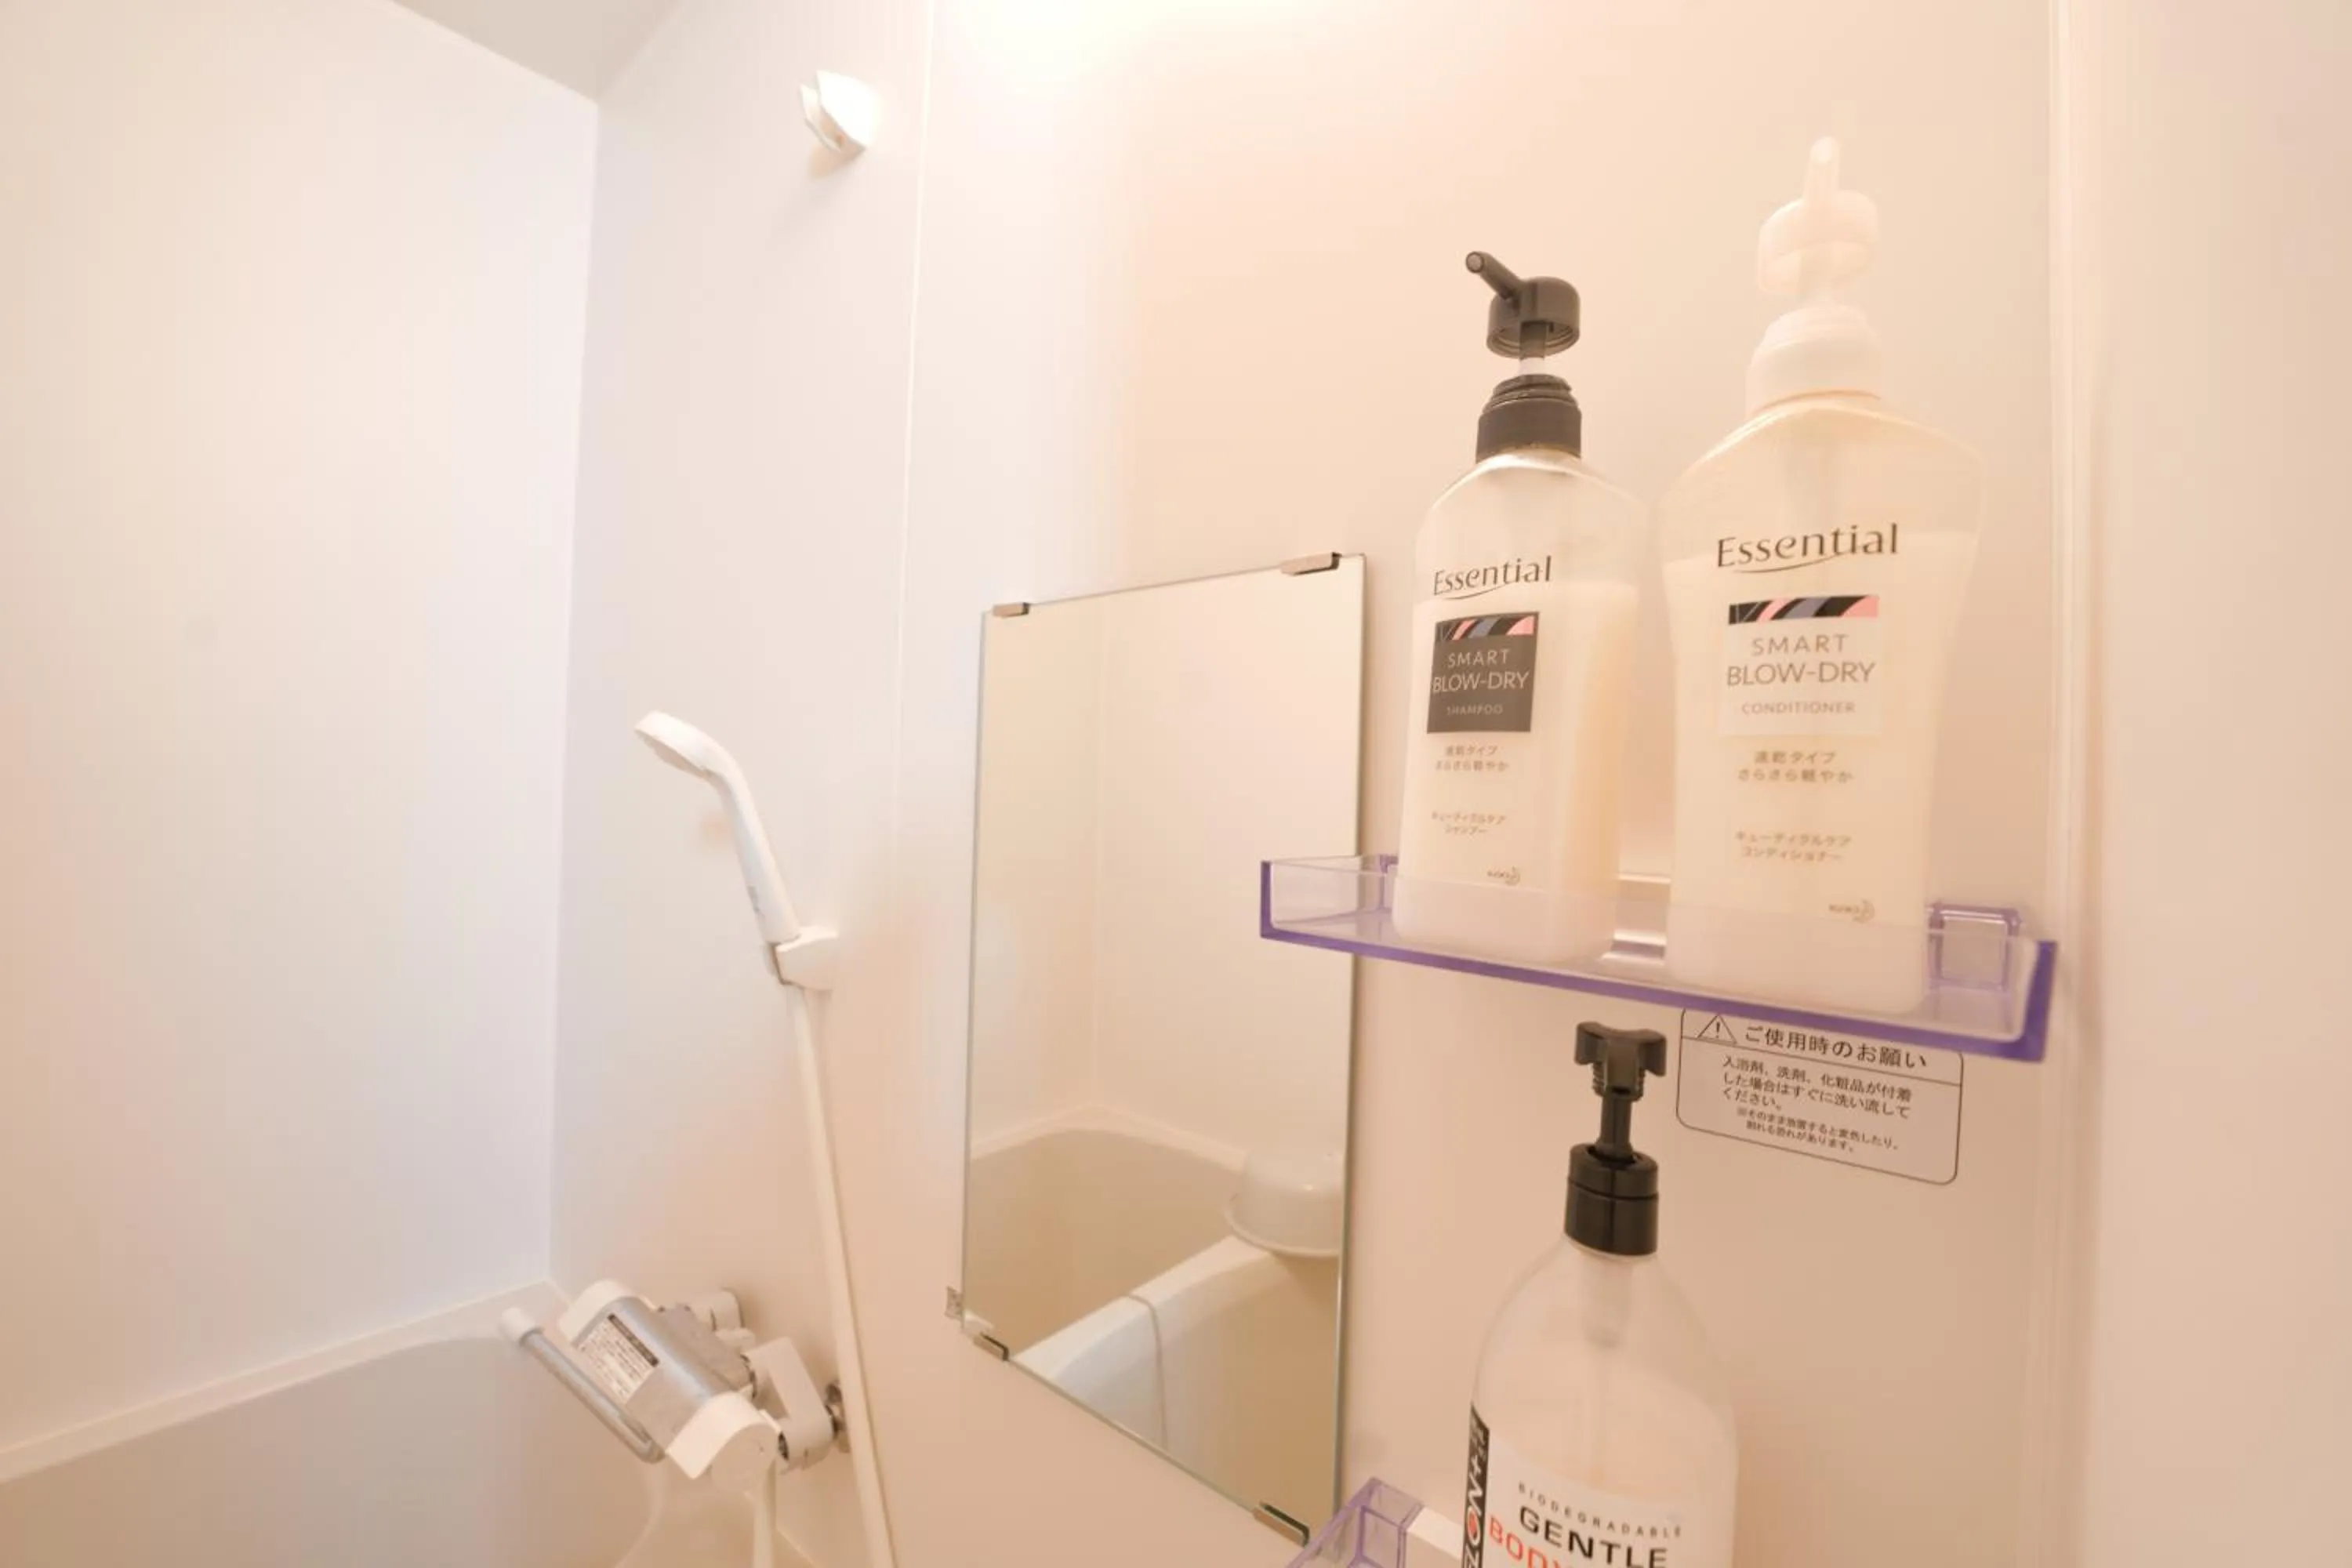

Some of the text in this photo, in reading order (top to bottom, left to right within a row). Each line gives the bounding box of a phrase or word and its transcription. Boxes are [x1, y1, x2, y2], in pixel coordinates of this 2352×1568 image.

[1717, 522, 1898, 568] Essential
[1432, 555, 1552, 596] Essential
[1447, 648, 1510, 668] SMART
[1751, 634, 1849, 656] SMART
[1431, 670, 1530, 695] BLOW-DRY
[1726, 662, 1877, 688] BLOW-DRY
[1446, 704, 1504, 717] SHAMPOO
[1740, 702, 1856, 716] CONDITIONER
[1744, 1025, 1927, 1069] ご使用時のお願い
[1518, 1480, 1681, 1538] BIODEGRADABLE
[1490, 1515, 1562, 1568] BOD
[1520, 1504, 1668, 1568] GENTLE
